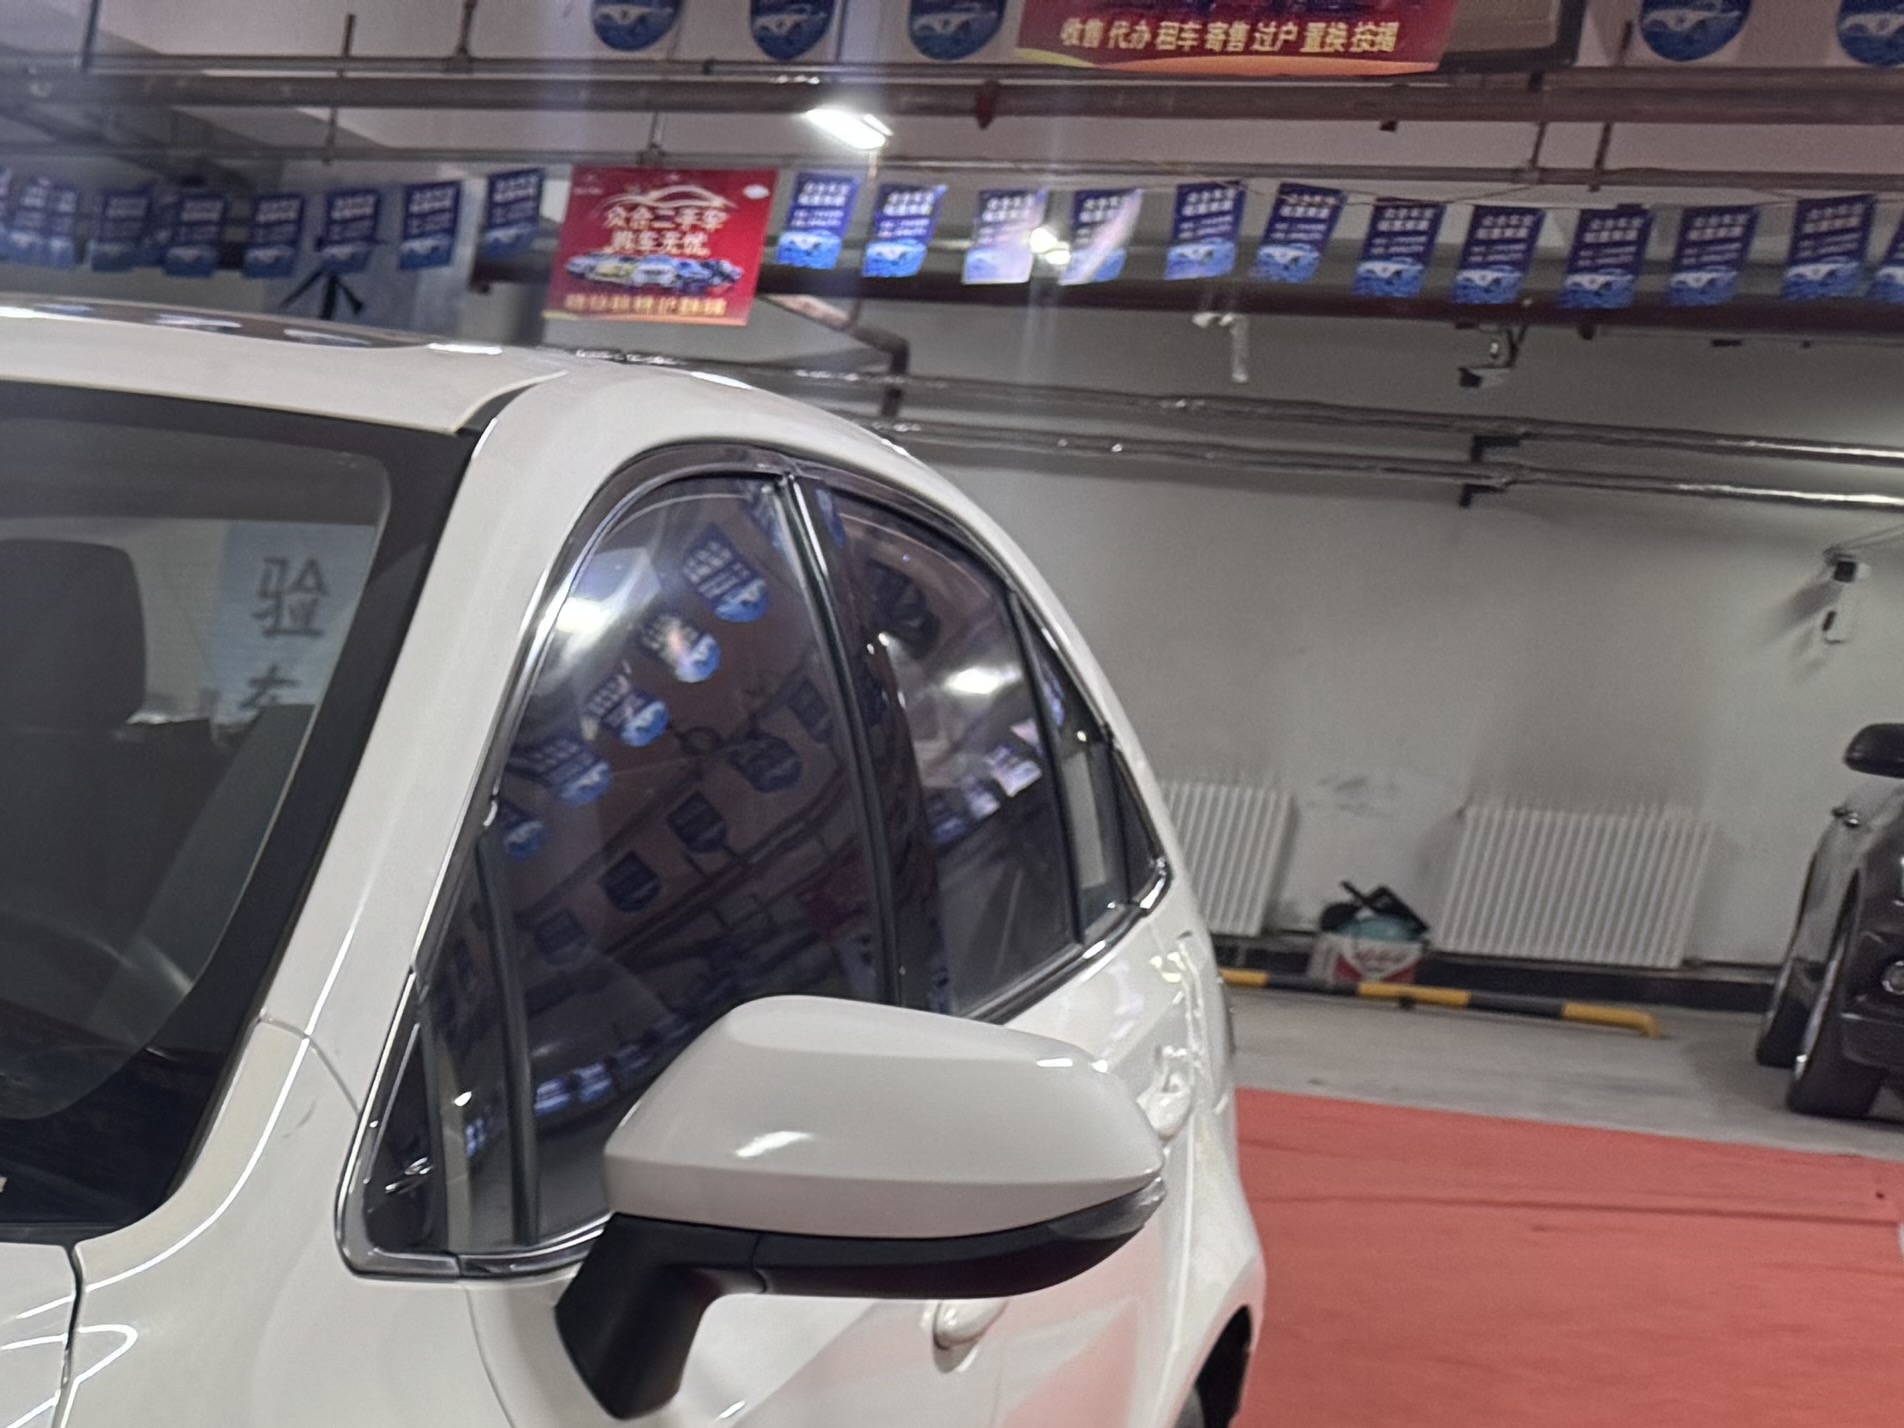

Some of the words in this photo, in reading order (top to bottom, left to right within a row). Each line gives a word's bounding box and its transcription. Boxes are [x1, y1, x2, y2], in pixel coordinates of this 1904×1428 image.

[1108, 19, 1152, 50] 代办
[1155, 20, 1202, 51] 租车
[1204, 20, 1250, 53] 寄售
[1251, 20, 1300, 52] 过户
[1301, 20, 1348, 53] 置换
[604, 205, 731, 232] 众合二手车
